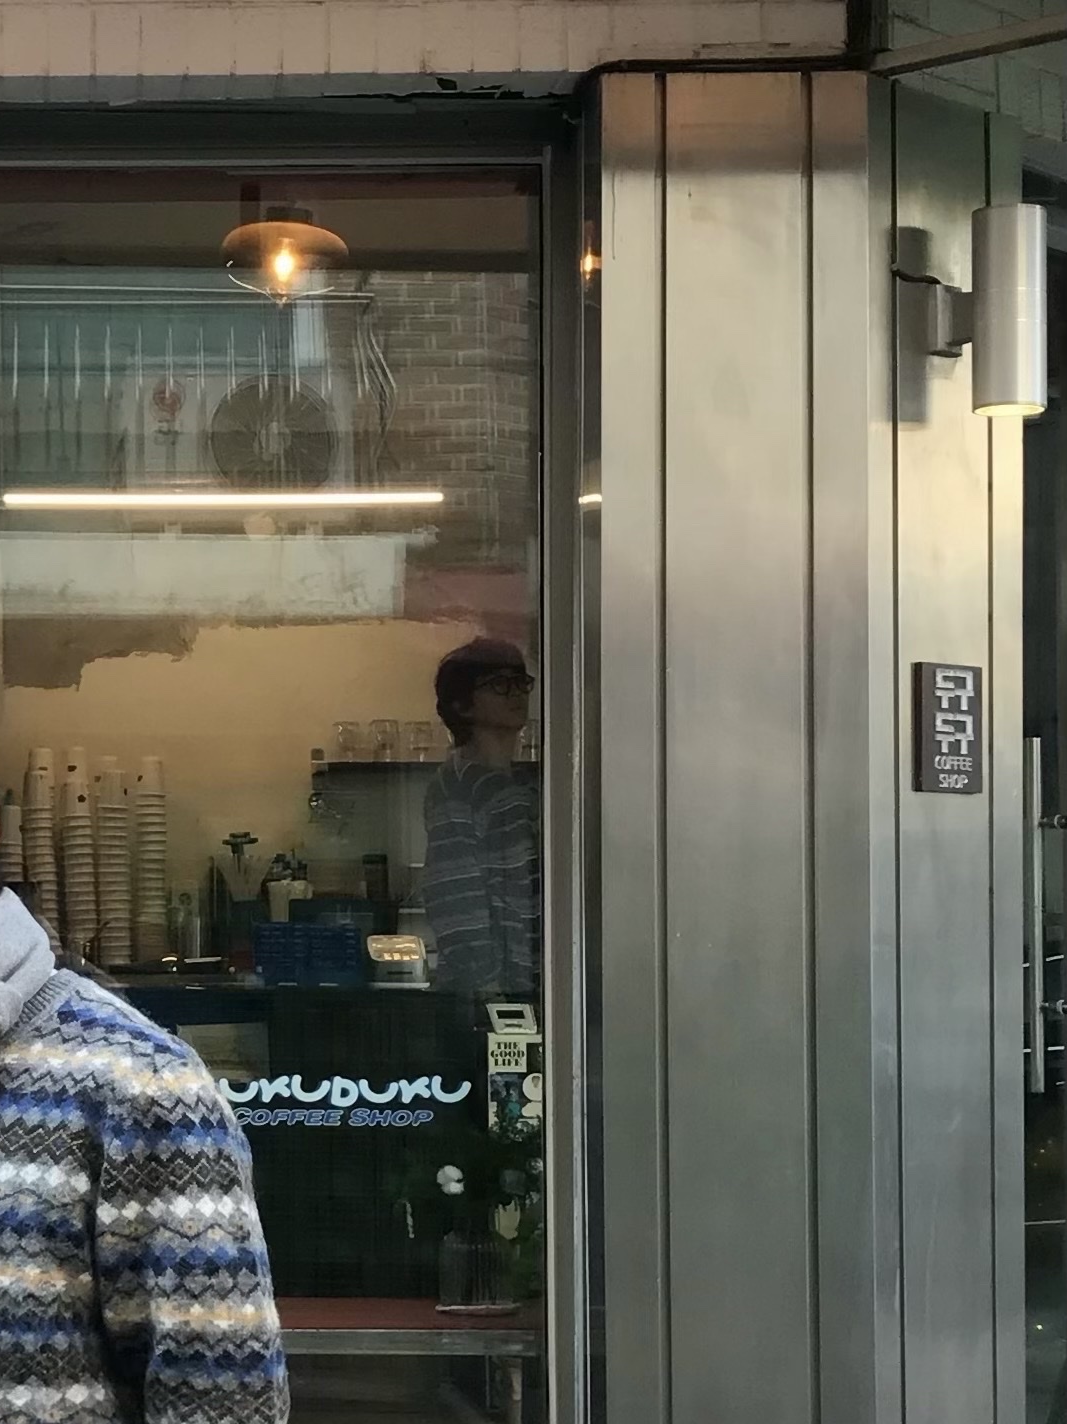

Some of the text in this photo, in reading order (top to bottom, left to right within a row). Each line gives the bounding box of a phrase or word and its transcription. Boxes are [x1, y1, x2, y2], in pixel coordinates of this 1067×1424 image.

[934, 755, 973, 771] COFFEE
[938, 773, 969, 788] SHOP
[495, 1042, 520, 1050] THE
[490, 1050, 525, 1058] GOOD
[494, 1058, 522, 1067] LIFE
[219, 1074, 472, 1107] UKUDUKU
[232, 1107, 434, 1126] COFFEE SHOP
